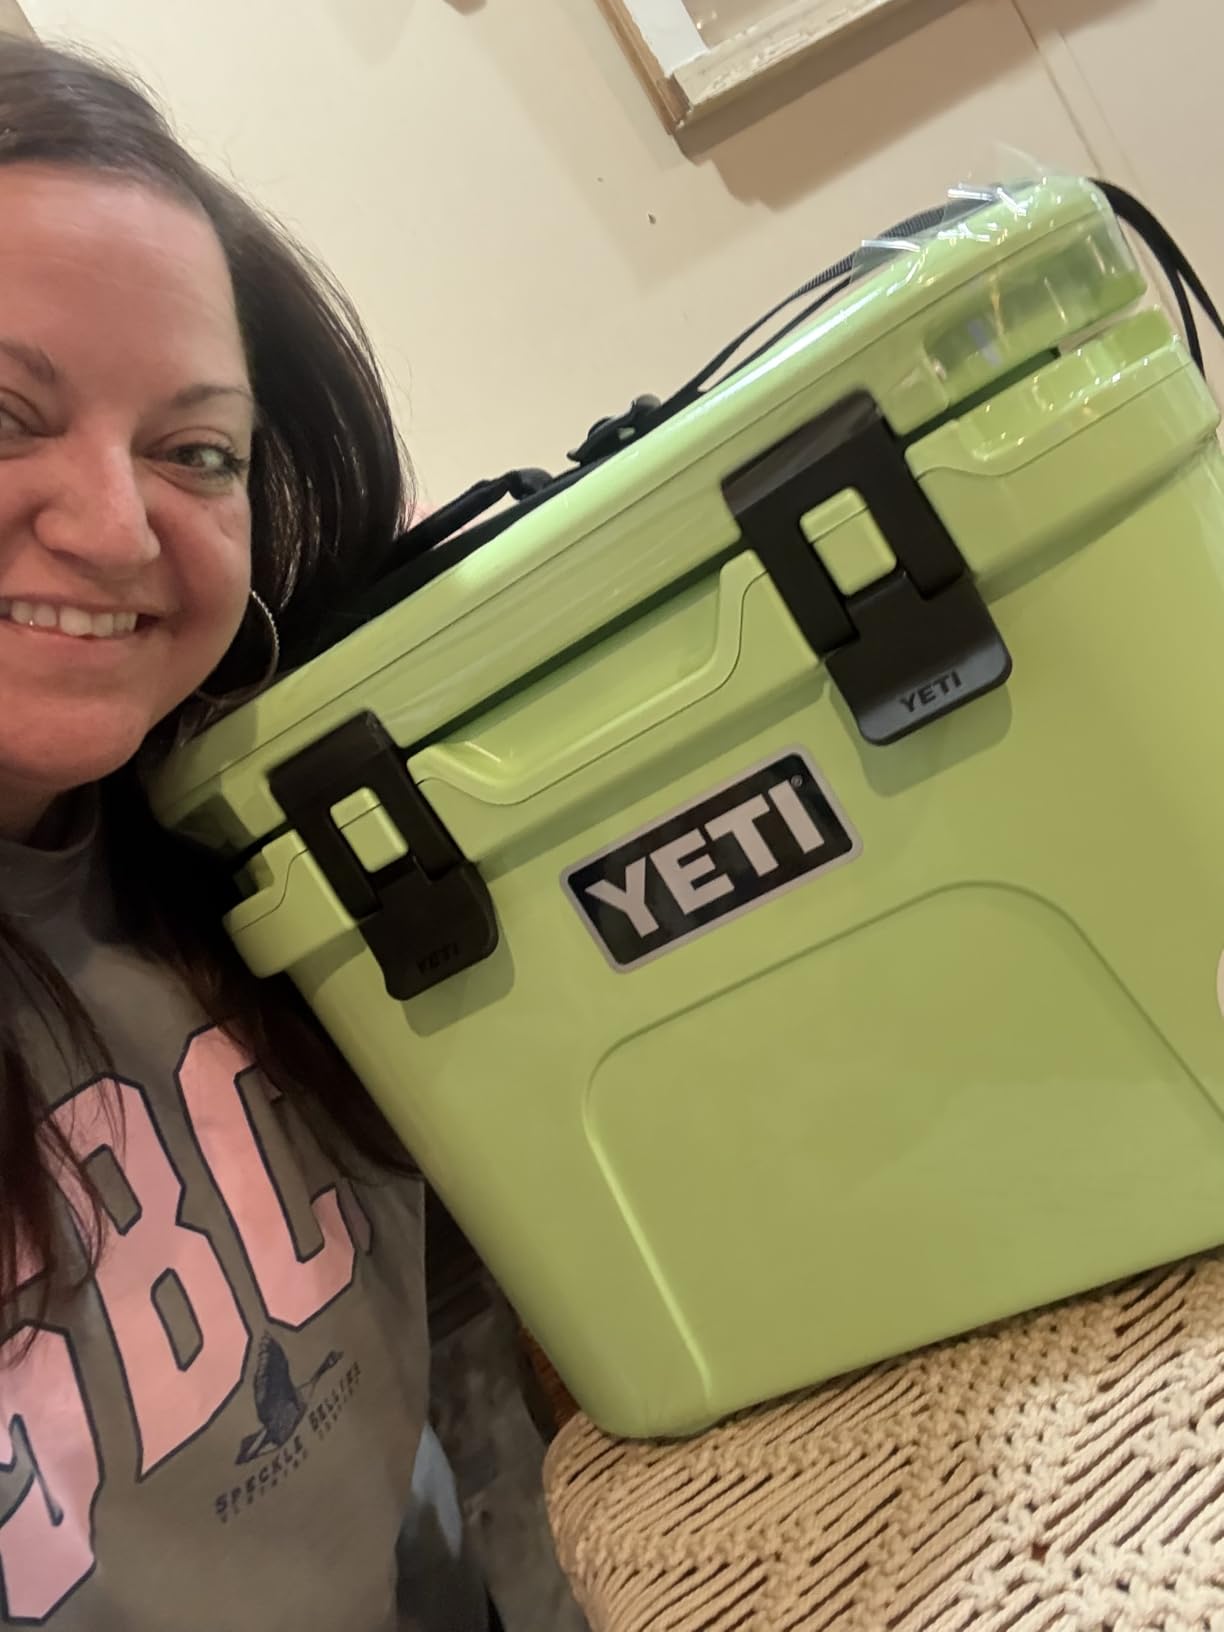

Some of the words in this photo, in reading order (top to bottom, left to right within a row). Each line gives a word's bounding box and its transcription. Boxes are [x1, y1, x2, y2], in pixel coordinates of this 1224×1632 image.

[901, 670, 962, 713] YETI
[584, 779, 825, 938] YETI
[215, 1435, 303, 1514] SPECKLE
